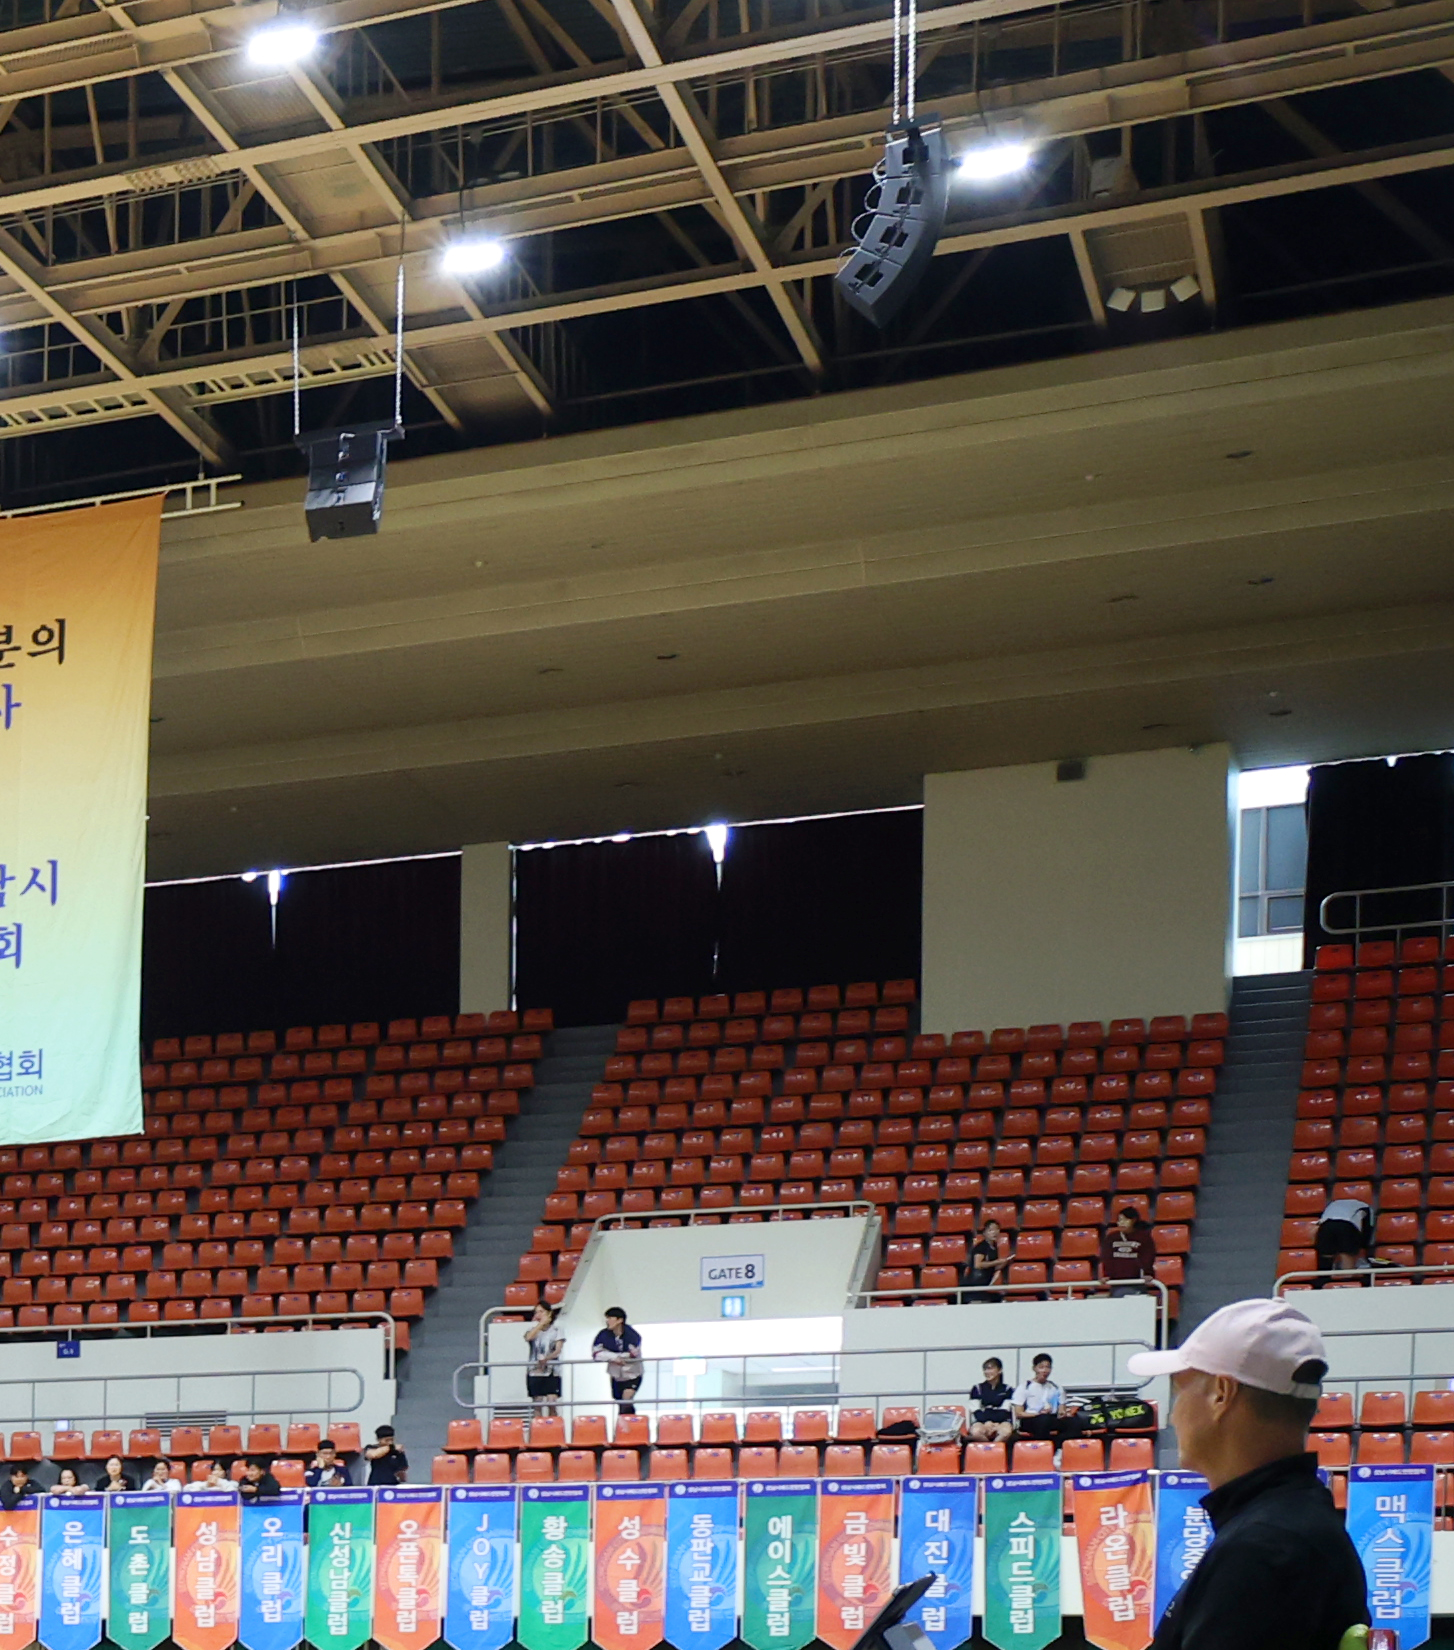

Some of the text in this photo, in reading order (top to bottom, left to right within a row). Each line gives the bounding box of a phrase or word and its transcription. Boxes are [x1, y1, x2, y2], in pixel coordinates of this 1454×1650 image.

[60, 1520, 86, 1626] 은혜클럽
[128, 1526, 151, 1634] 도촌클럽
[194, 1520, 219, 1628] 성남클럽
[260, 1517, 285, 1624] 오리클럽
[326, 1521, 353, 1635] 신성남클럽
[469, 1512, 490, 1631] JOY클럽
[541, 1514, 568, 1625] 황송클럽
[616, 1515, 641, 1635] 성수클럽
[687, 1513, 714, 1634] 동판교클럽
[766, 1514, 793, 1637] 에이스클럽
[839, 1511, 868, 1632] 금빛클럽
[921, 1508, 951, 1633] 대진클럽
[1008, 1510, 1036, 1636] 스피드클럽
[1099, 1502, 1136, 1624] 라온클럽
[1373, 1493, 1408, 1621] 맥스클럽
